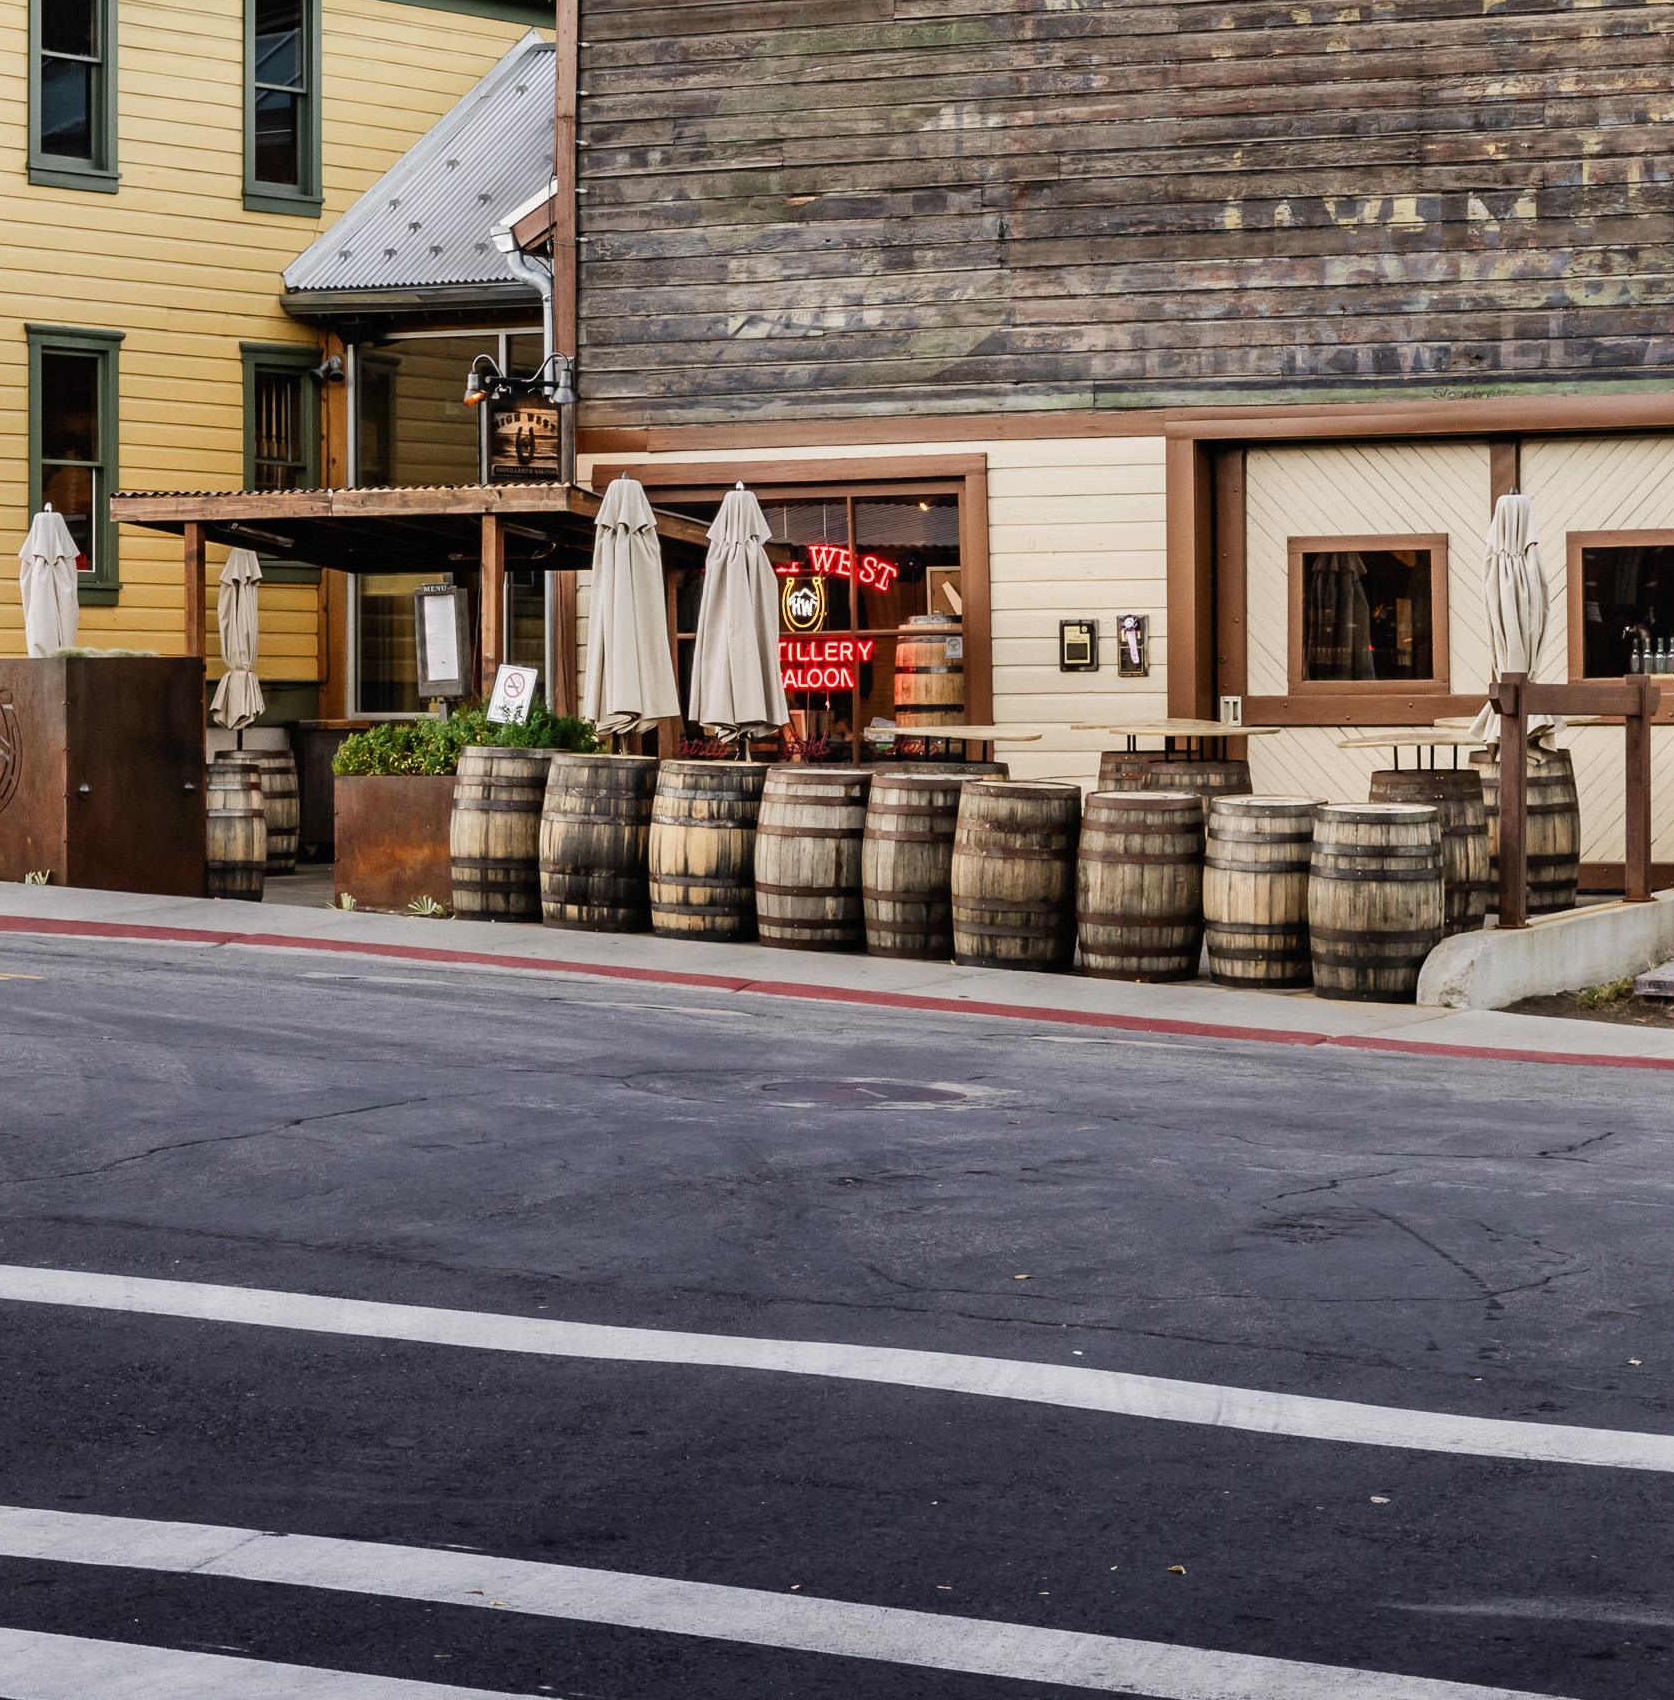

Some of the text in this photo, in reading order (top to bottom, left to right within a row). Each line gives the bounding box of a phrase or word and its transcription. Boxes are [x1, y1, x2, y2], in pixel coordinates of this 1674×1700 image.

[527, 412, 556, 433] WEST
[808, 545, 897, 591] WEST
[778, 641, 873, 661] TILLERY
[782, 668, 854, 688] ALOON
